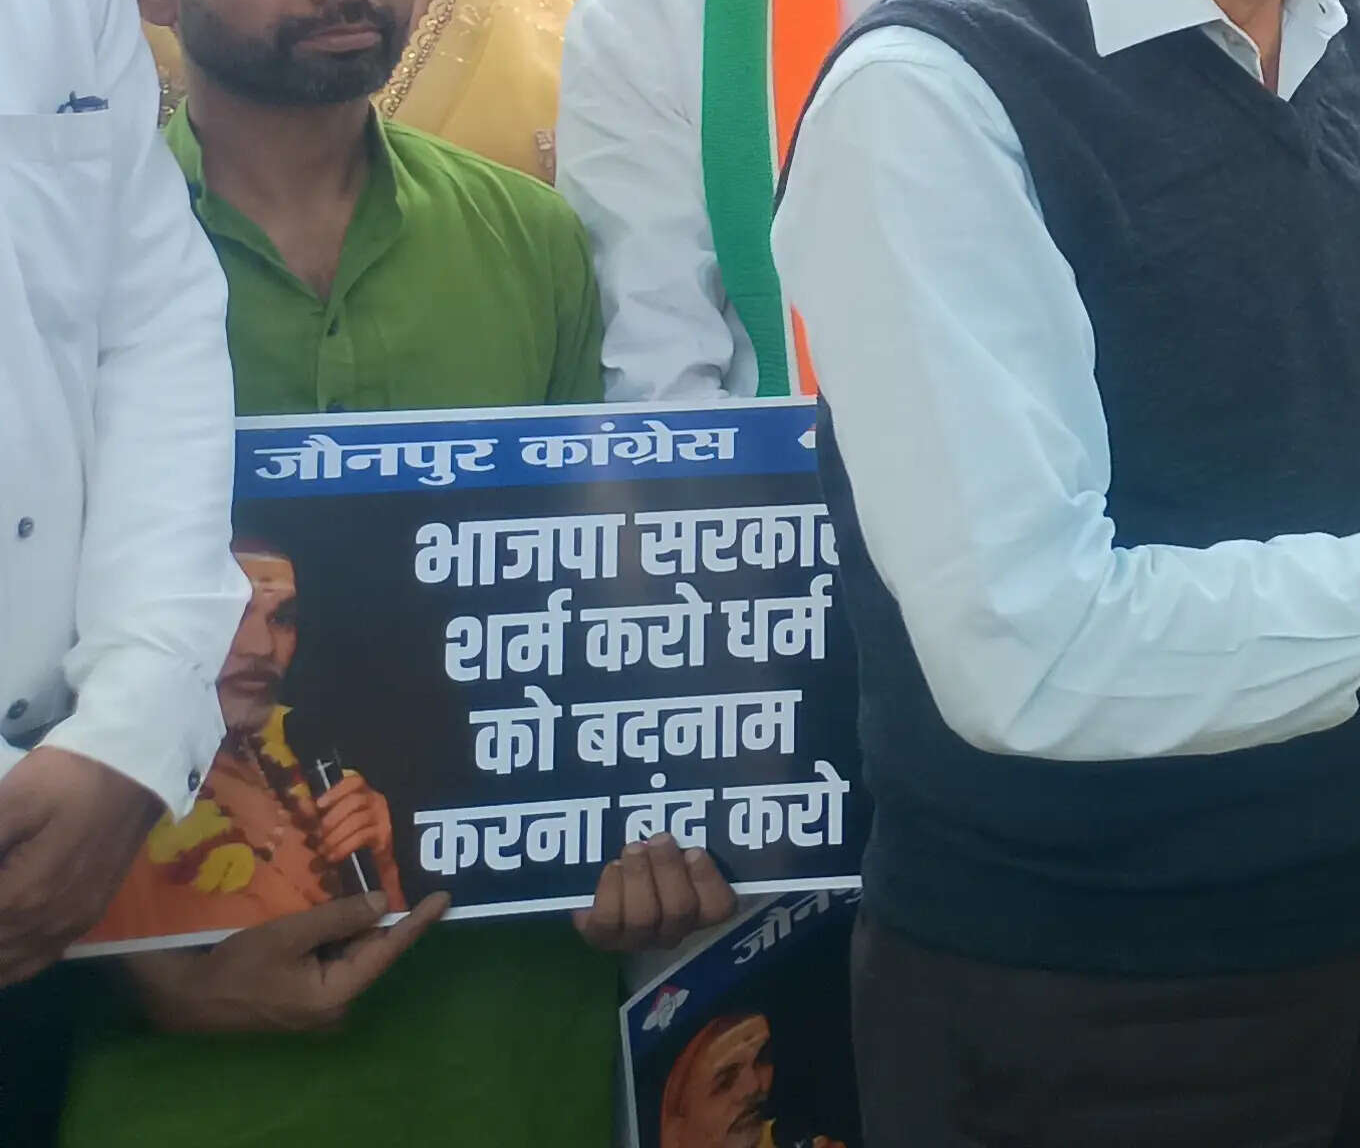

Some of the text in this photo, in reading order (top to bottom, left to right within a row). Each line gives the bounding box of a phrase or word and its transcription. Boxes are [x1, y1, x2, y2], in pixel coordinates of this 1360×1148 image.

[254, 421, 738, 486] जौनपुर कांग्रेस
[414, 513, 624, 586] भाजपा
[445, 574, 833, 682] शर्म करो धर्म
[469, 686, 802, 774] को बदनाम
[413, 761, 849, 876] करना बंद करो
